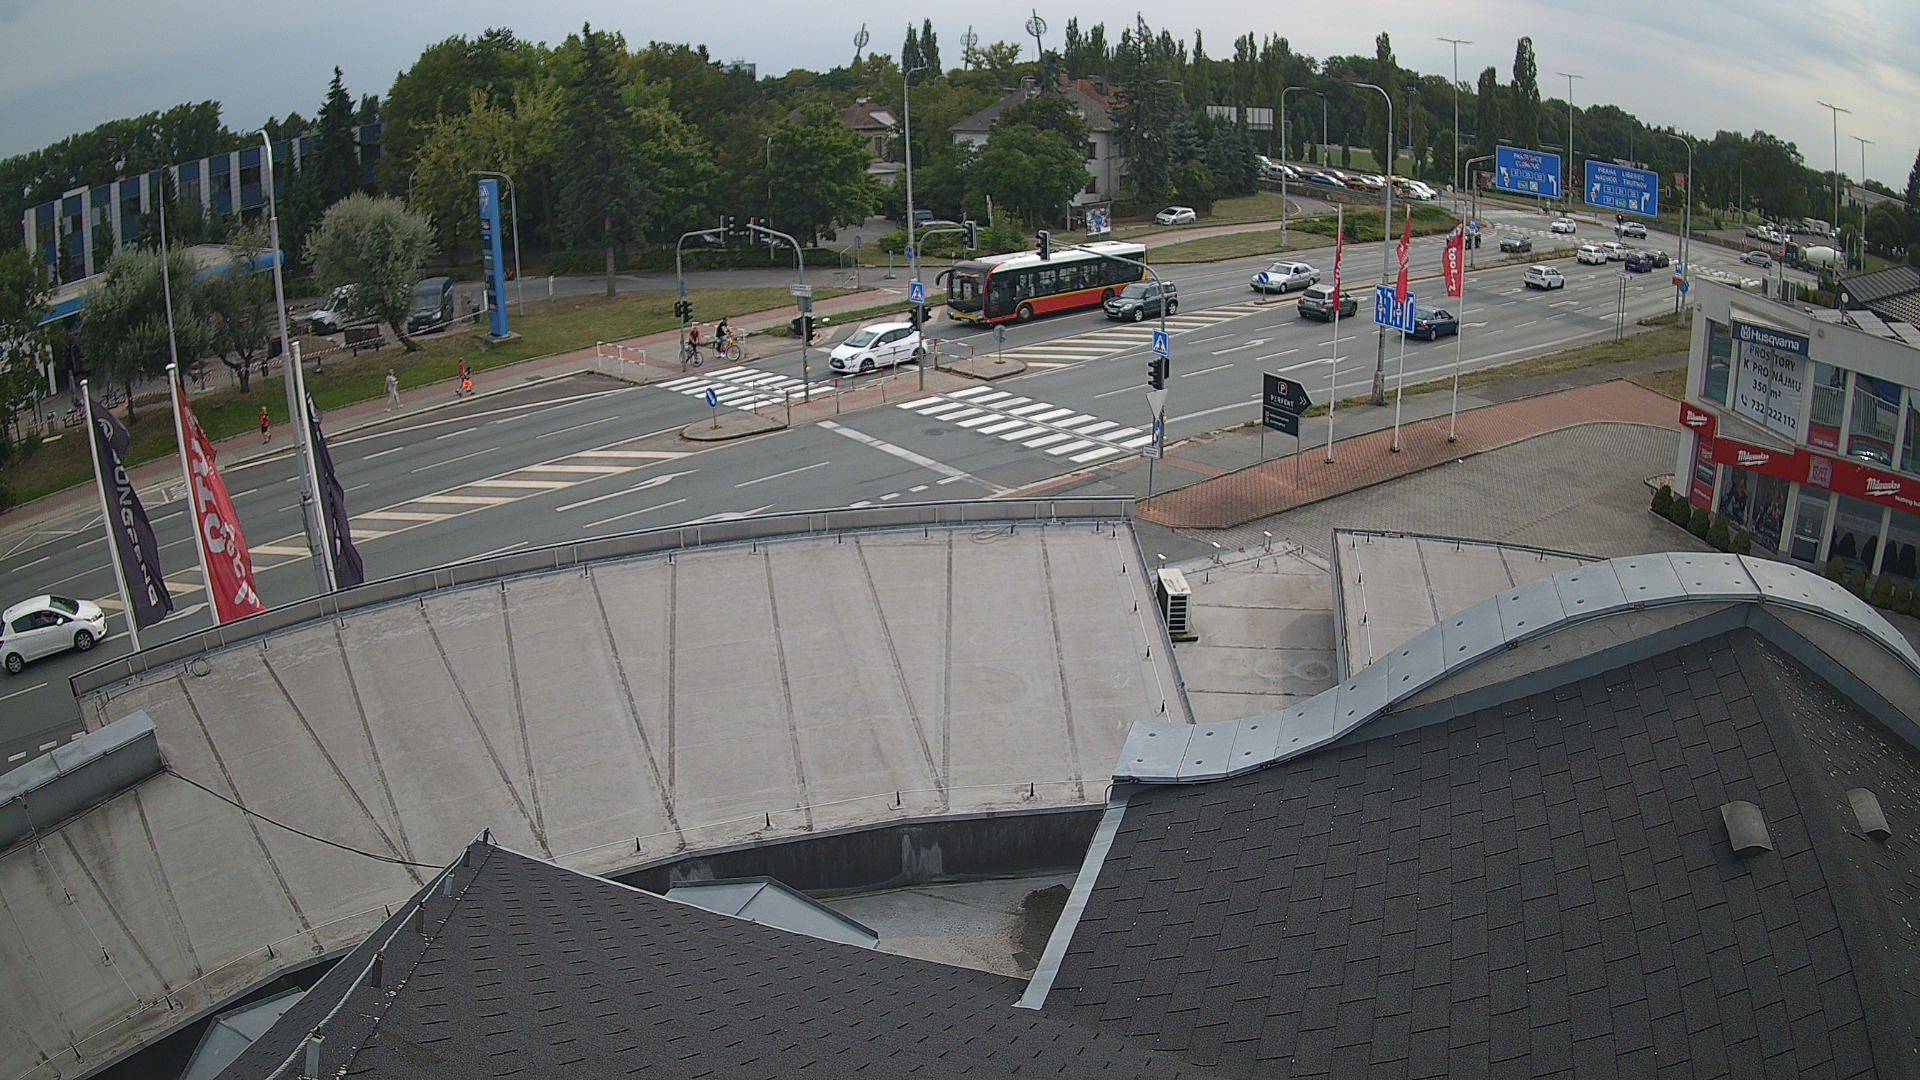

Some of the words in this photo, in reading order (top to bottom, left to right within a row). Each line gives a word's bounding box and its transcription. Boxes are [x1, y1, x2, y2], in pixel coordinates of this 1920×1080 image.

[1598, 167, 1617, 176] PRAHA
[1621, 170, 1645, 182] LIBEREC
[1623, 179, 1648, 190] TRUTNOV
[1751, 328, 1800, 351] Husqvarna
[1743, 358, 1749, 369] K
[1752, 379, 1767, 394] 350
[1751, 398, 1765, 415] 732
[1738, 449, 1769, 462] Milwaukee
[1866, 477, 1901, 491] Milwaukee
